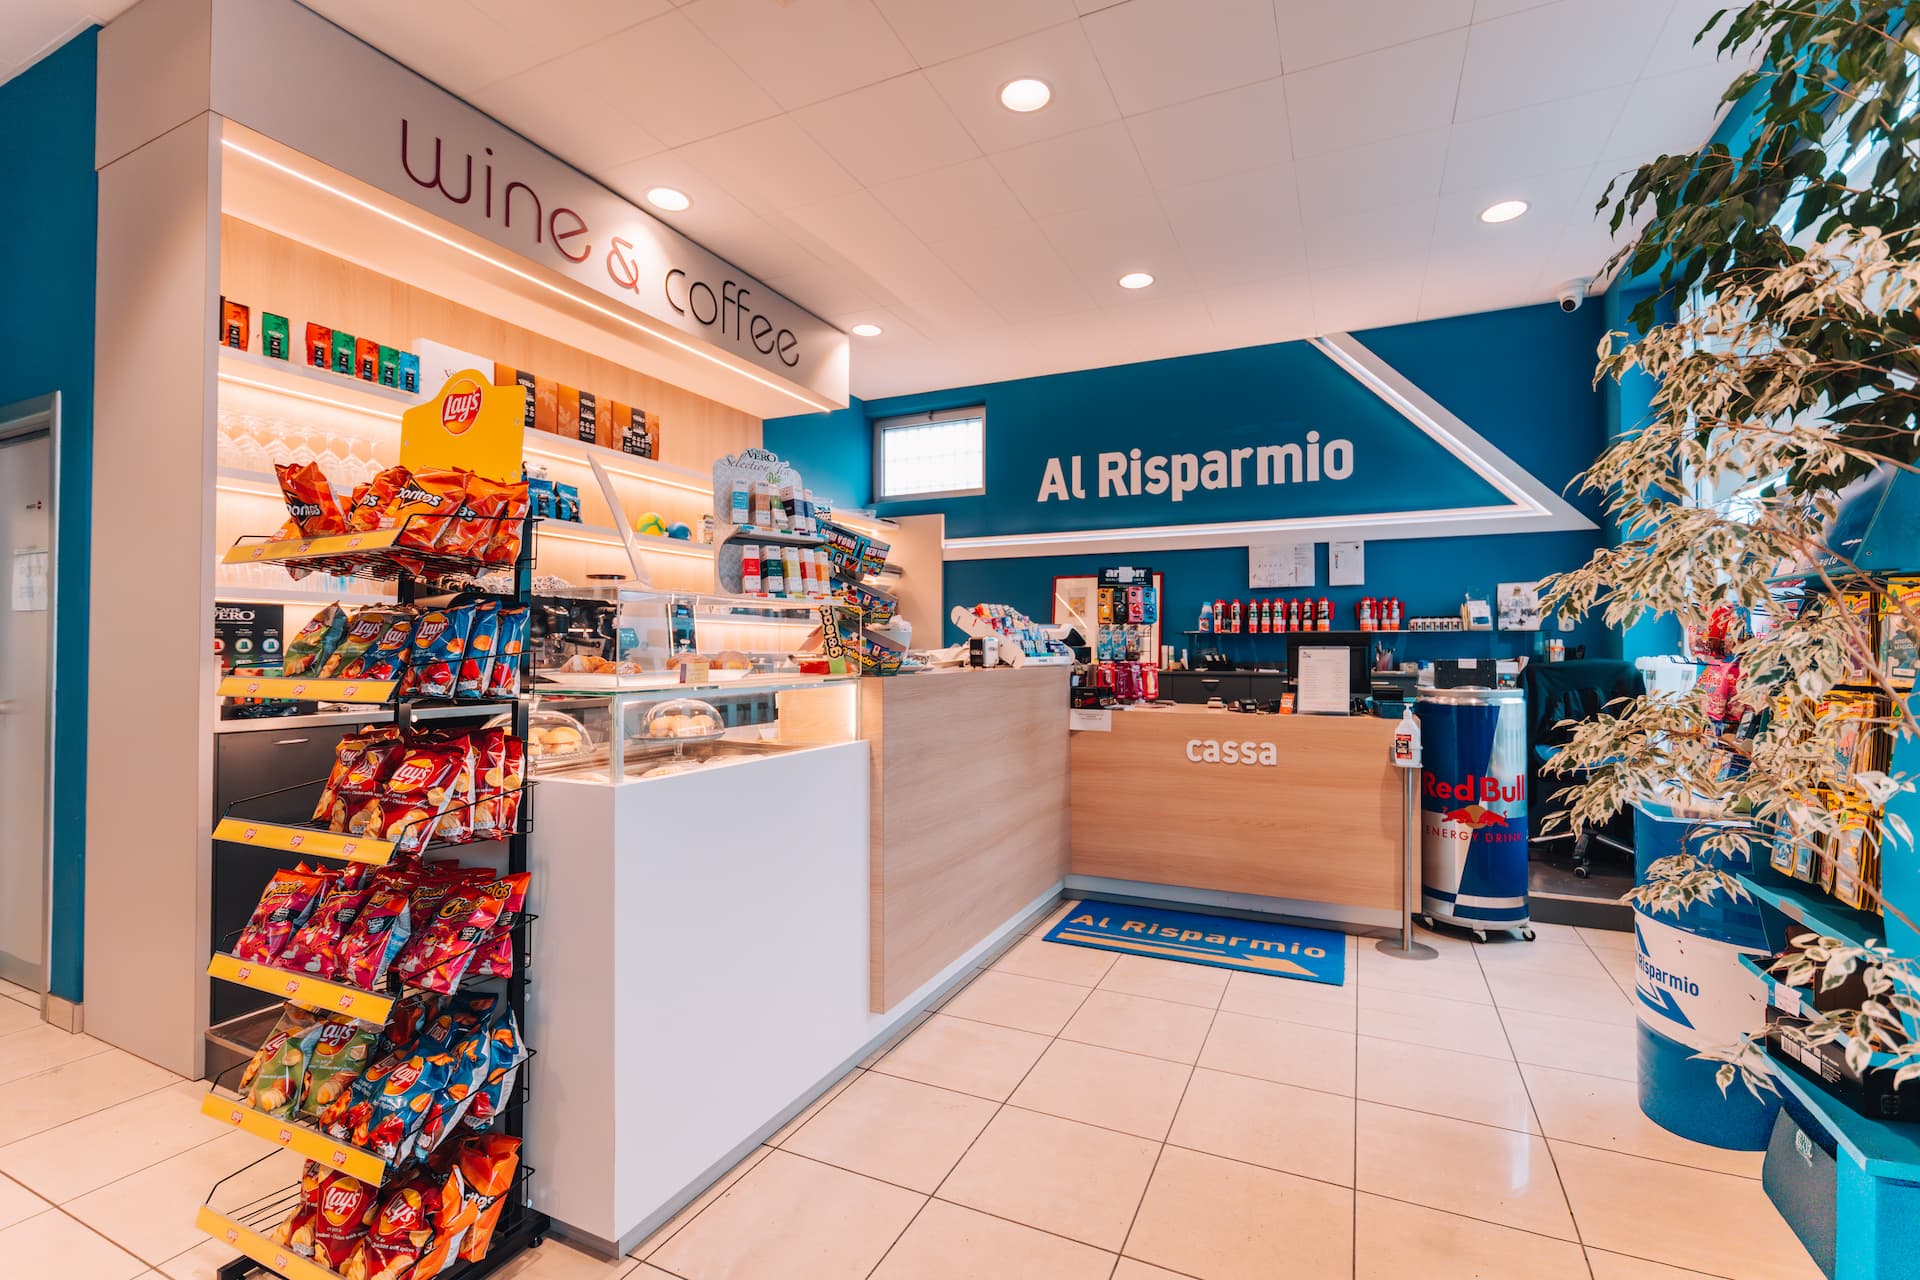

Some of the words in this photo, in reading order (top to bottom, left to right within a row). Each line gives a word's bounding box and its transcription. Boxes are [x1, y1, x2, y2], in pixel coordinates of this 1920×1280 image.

[402, 118, 591, 264] wine
[606, 236, 640, 295] &
[665, 267, 801, 367] coffee
[444, 390, 481, 423] Lay's
[746, 450, 777, 463] VERO
[1037, 456, 1086, 502] Al
[1098, 430, 1354, 502] Risparmio
[351, 619, 383, 639] Lay's
[418, 620, 448, 641] Lay's
[1186, 739, 1278, 766] cassa
[391, 763, 431, 784] Lay's
[1423, 771, 1476, 802] Red
[1480, 774, 1525, 803] Bull
[1425, 825, 1478, 842] ENERGY
[1484, 832, 1522, 844] DRINK
[1068, 914, 1109, 930] Al
[1120, 920, 1327, 960] Risparmio
[1638, 952, 1700, 997] Risparmio
[324, 1187, 361, 1215] Lay's
